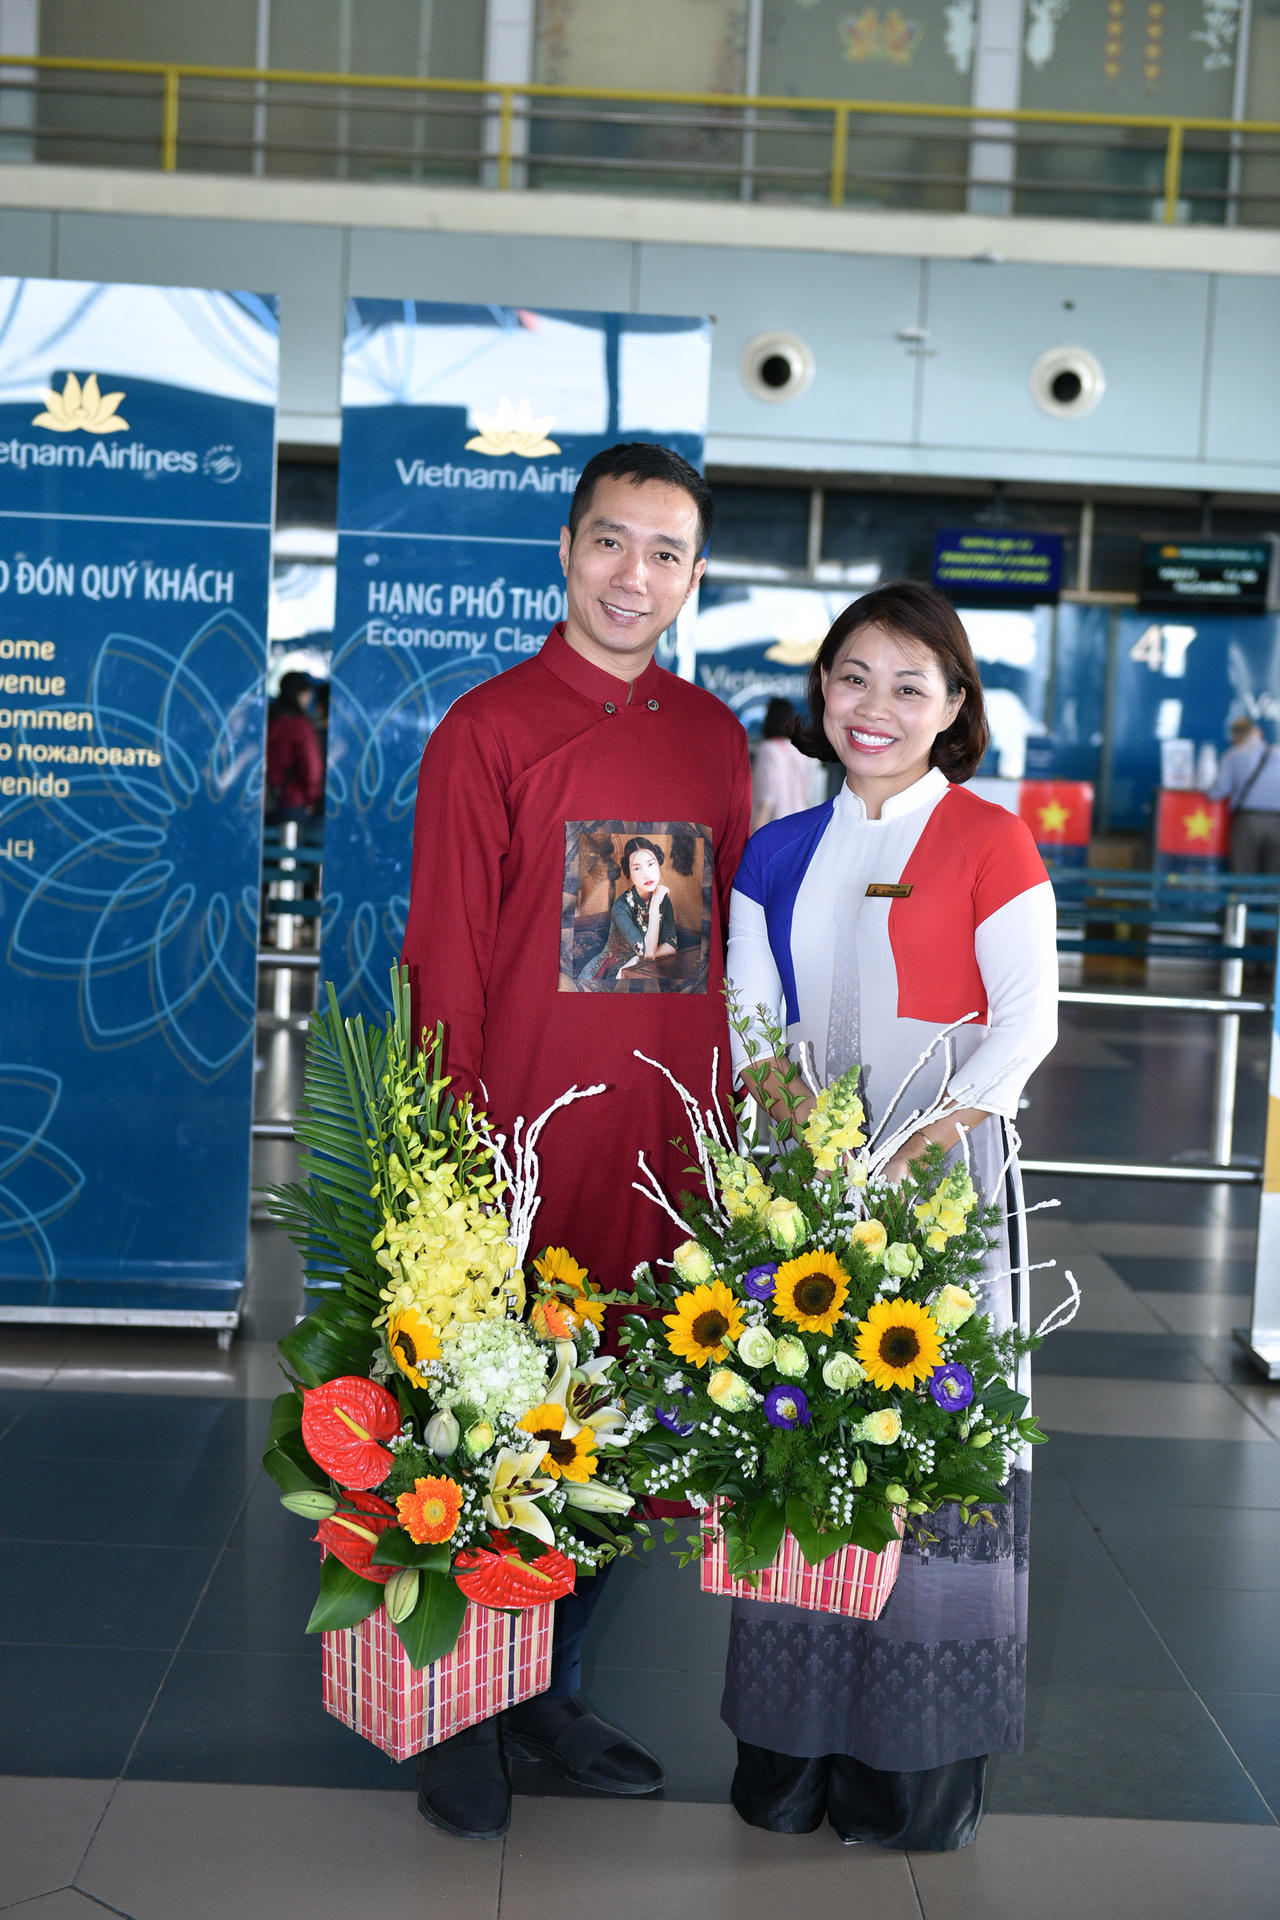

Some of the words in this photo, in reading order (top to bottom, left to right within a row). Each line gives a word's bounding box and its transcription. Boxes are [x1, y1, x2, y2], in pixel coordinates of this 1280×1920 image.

[86, 440, 199, 474] Airlines
[395, 457, 517, 491] Vietnam
[15, 556, 75, 597] ĐÓN
[81, 560, 138, 601] QUÝ
[144, 563, 235, 604] KHÁCH
[368, 580, 444, 621] HẠNG
[449, 577, 506, 619] PHỔ
[0, 638, 56, 661] ome
[366, 620, 488, 658] Economy
[17, 743, 161, 767] пожаловать
